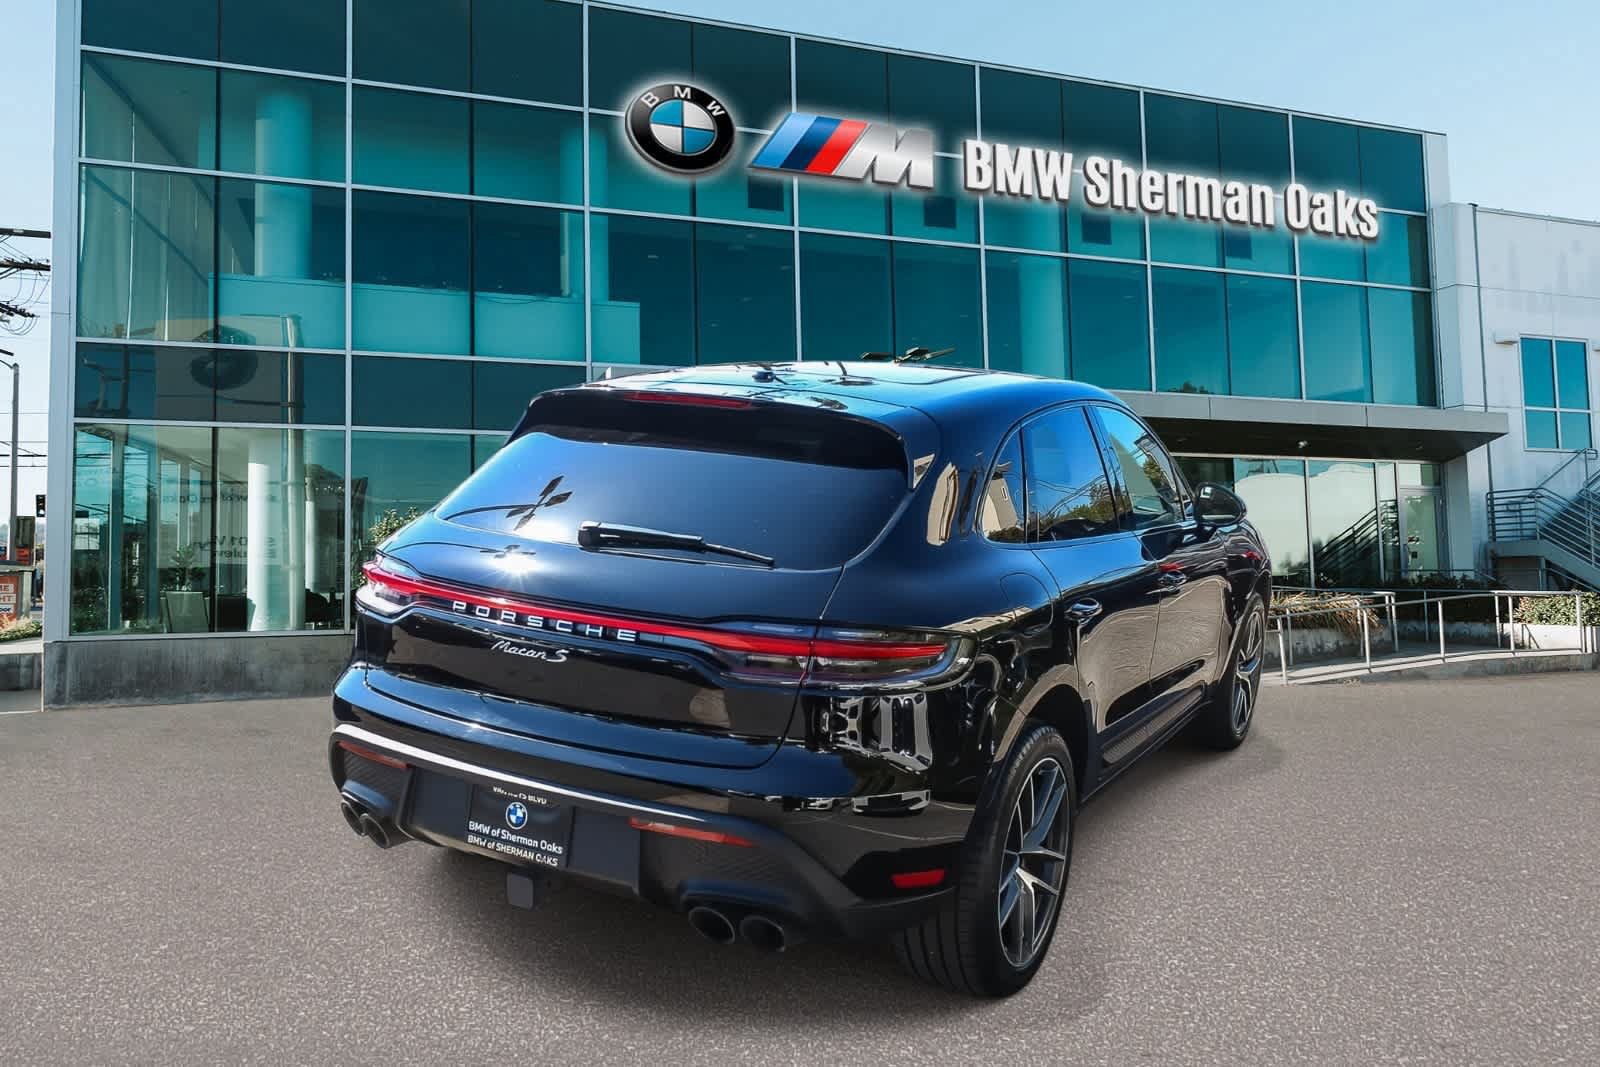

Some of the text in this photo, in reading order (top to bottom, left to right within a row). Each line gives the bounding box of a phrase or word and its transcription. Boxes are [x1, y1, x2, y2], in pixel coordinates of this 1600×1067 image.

[641, 85, 725, 117] BMW
[963, 139, 1380, 240] BMW Sherman Oaks
[452, 600, 637, 642] PORSCHE
[491, 639, 568, 663] Macan S
[468, 821, 564, 855] BMW of Sherman Oaks
[468, 835, 487, 847] BMW
[487, 841, 495, 849] of
[495, 843, 534, 861] SHERMAN
